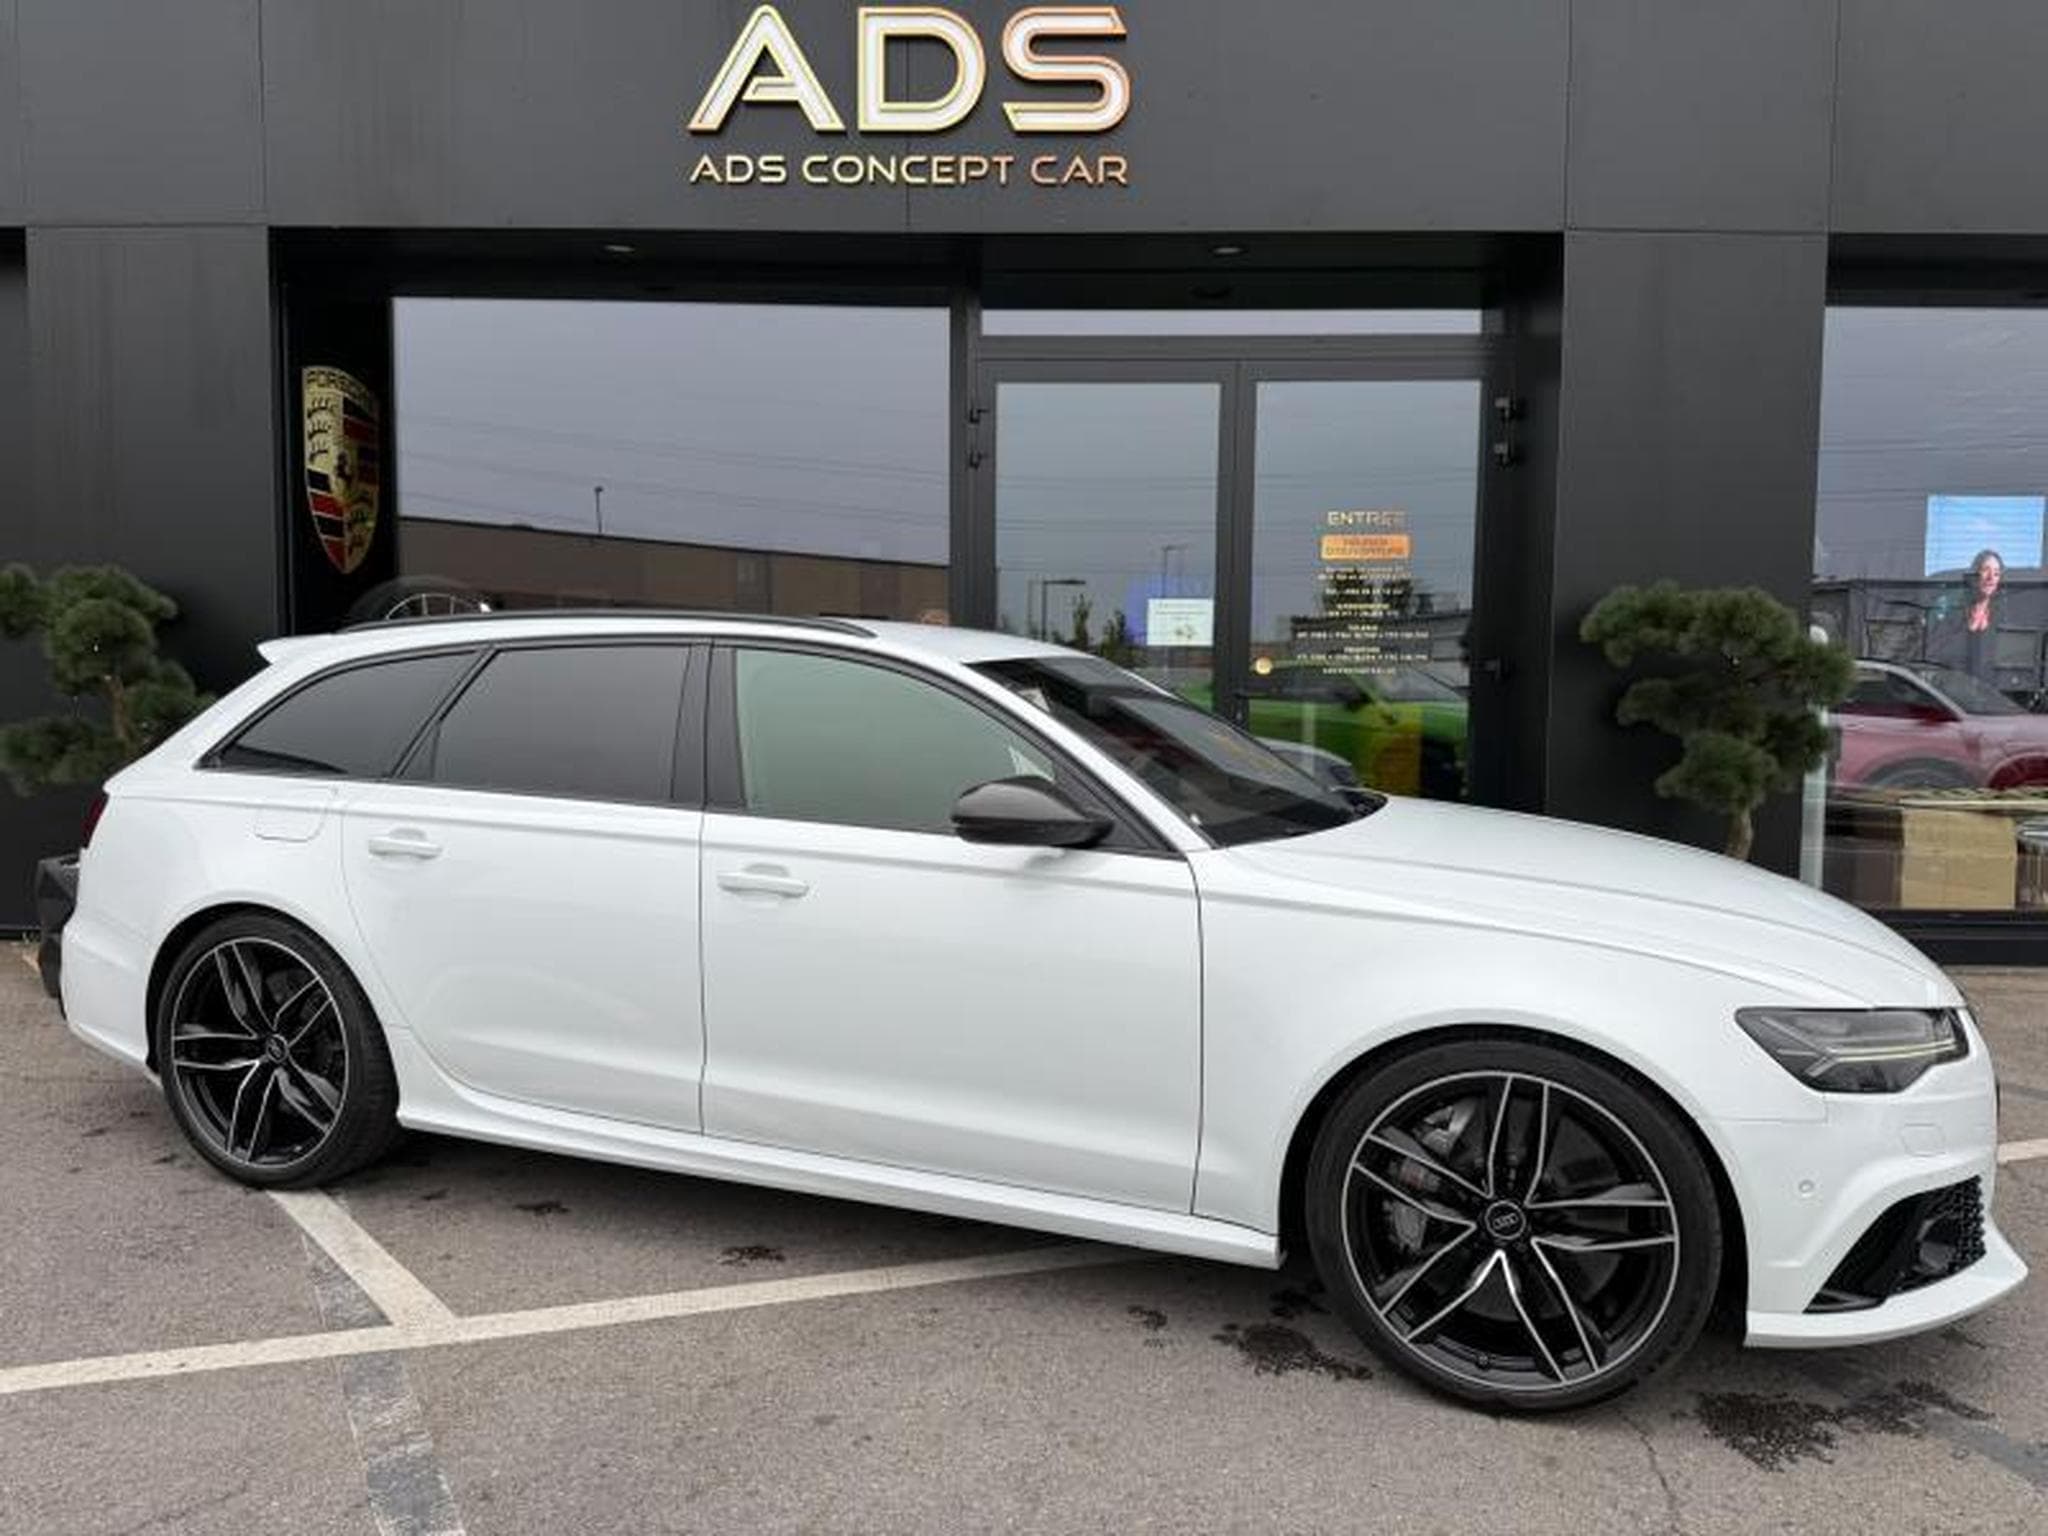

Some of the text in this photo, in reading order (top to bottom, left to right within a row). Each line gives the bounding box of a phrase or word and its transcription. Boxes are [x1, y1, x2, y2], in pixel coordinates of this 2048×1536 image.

[687, 4, 1131, 132] ADS
[689, 155, 1128, 185] ADS CONCEPT CAR
[305, 367, 375, 407] PORSC
